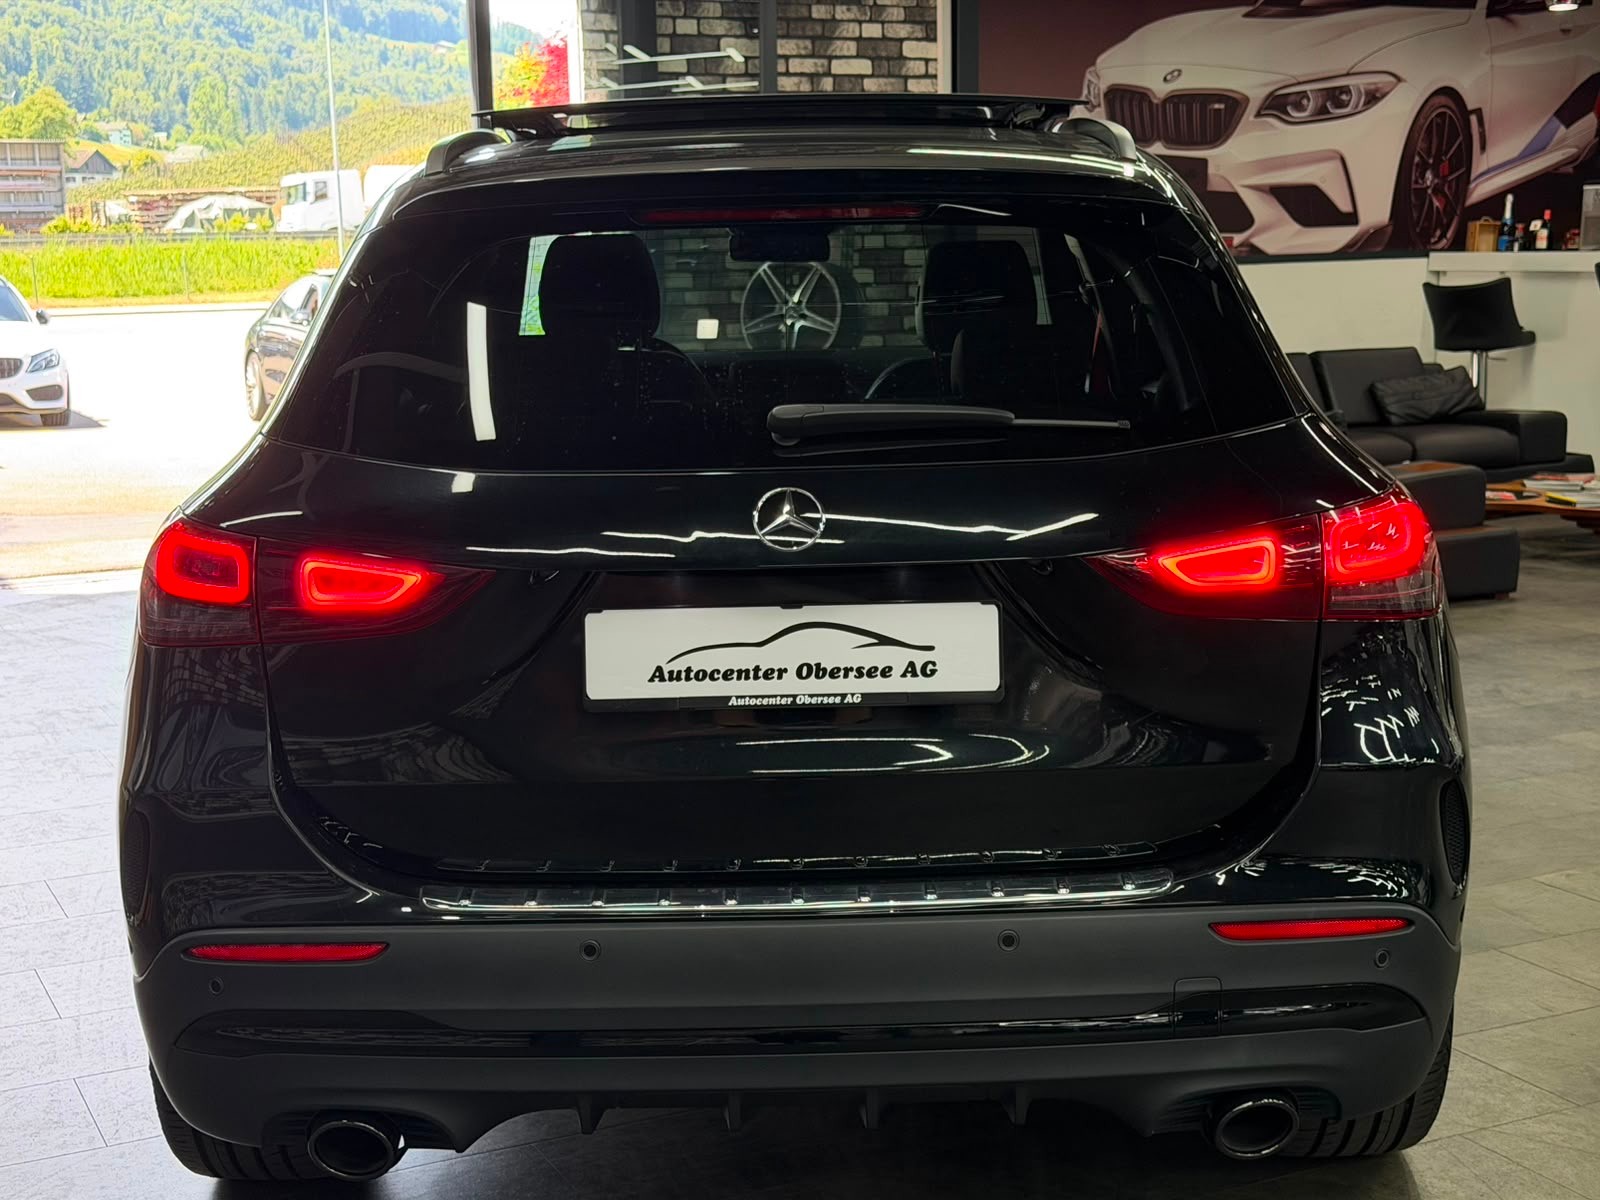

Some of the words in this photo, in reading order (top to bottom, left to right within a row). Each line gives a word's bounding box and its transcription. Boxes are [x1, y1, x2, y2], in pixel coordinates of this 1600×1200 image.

[648, 664, 788, 682] Autocenter
[795, 662, 894, 680] Obersee
[900, 660, 938, 678] AG
[728, 696, 793, 706] Autocenter
[796, 695, 842, 704] Obersee
[844, 694, 862, 703] AG
